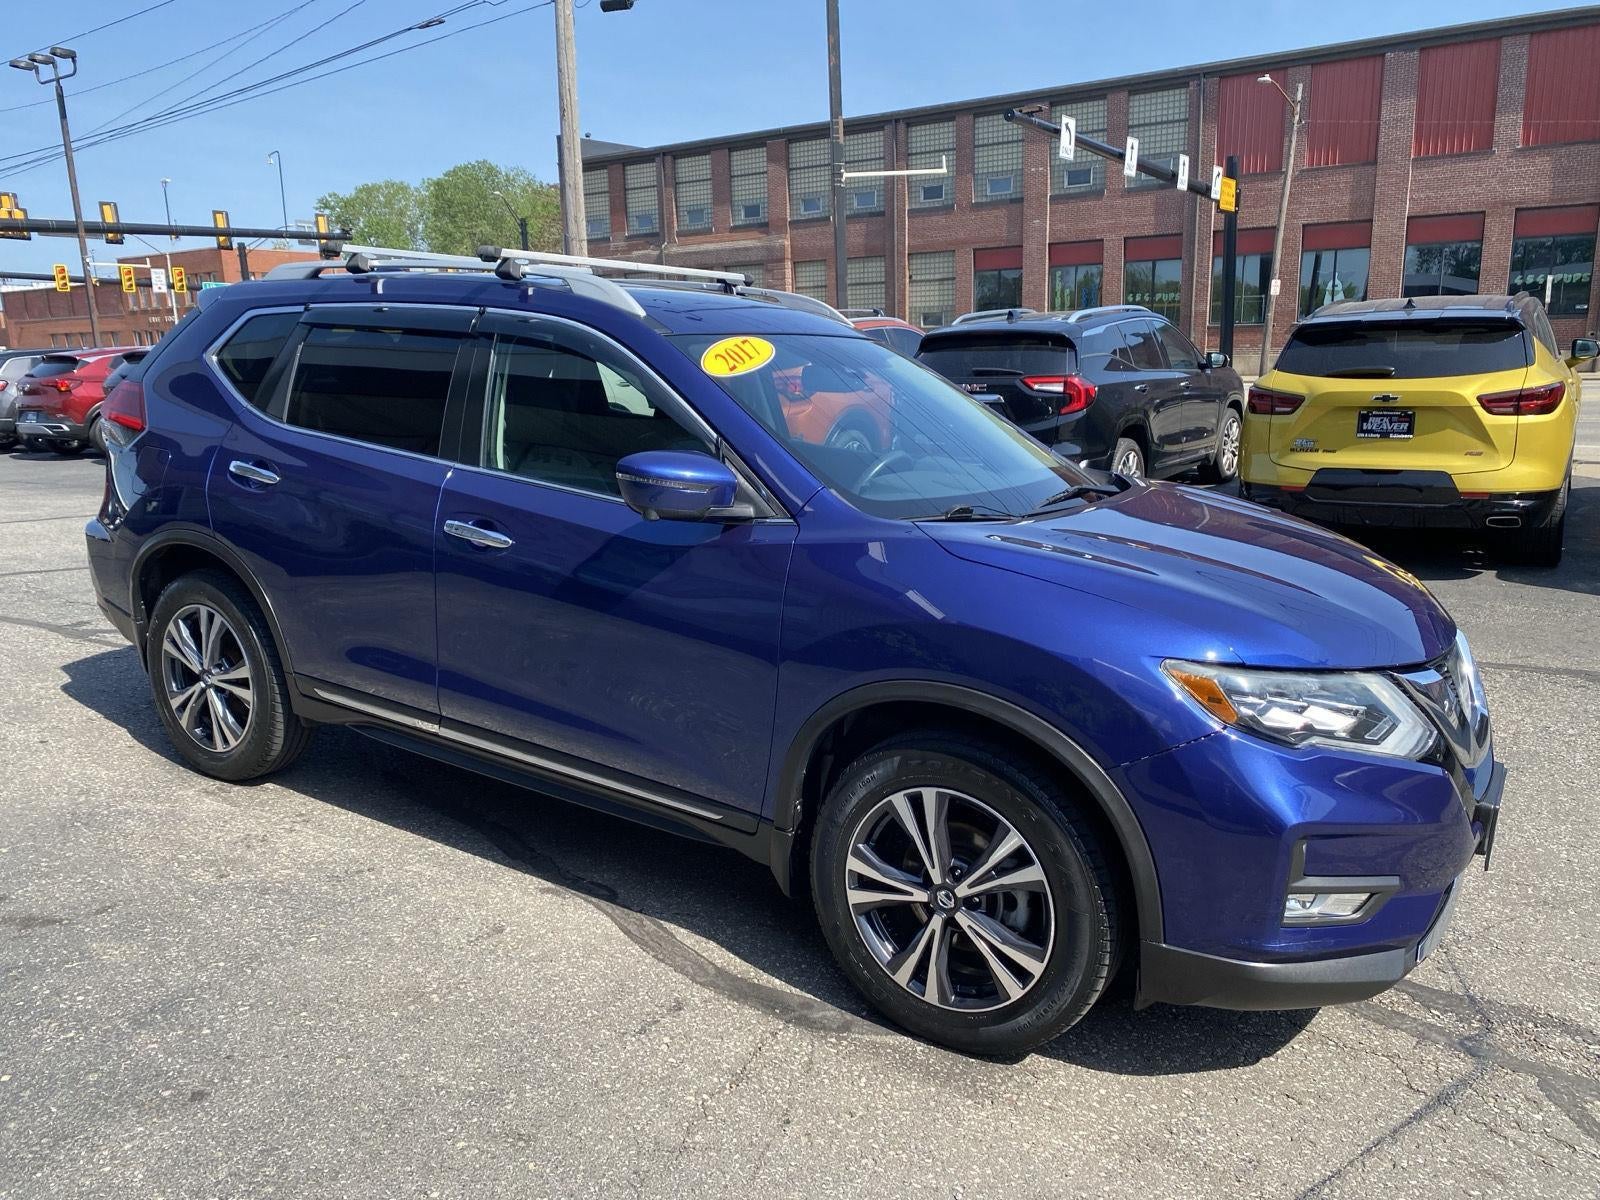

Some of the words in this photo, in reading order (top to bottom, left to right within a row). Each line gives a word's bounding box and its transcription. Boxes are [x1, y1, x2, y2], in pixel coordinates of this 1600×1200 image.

[1553, 272, 1592, 284] PUPS
[714, 339, 761, 372] 2017
[1369, 416, 1391, 424] RICK
[1362, 422, 1409, 430] WEAVER
